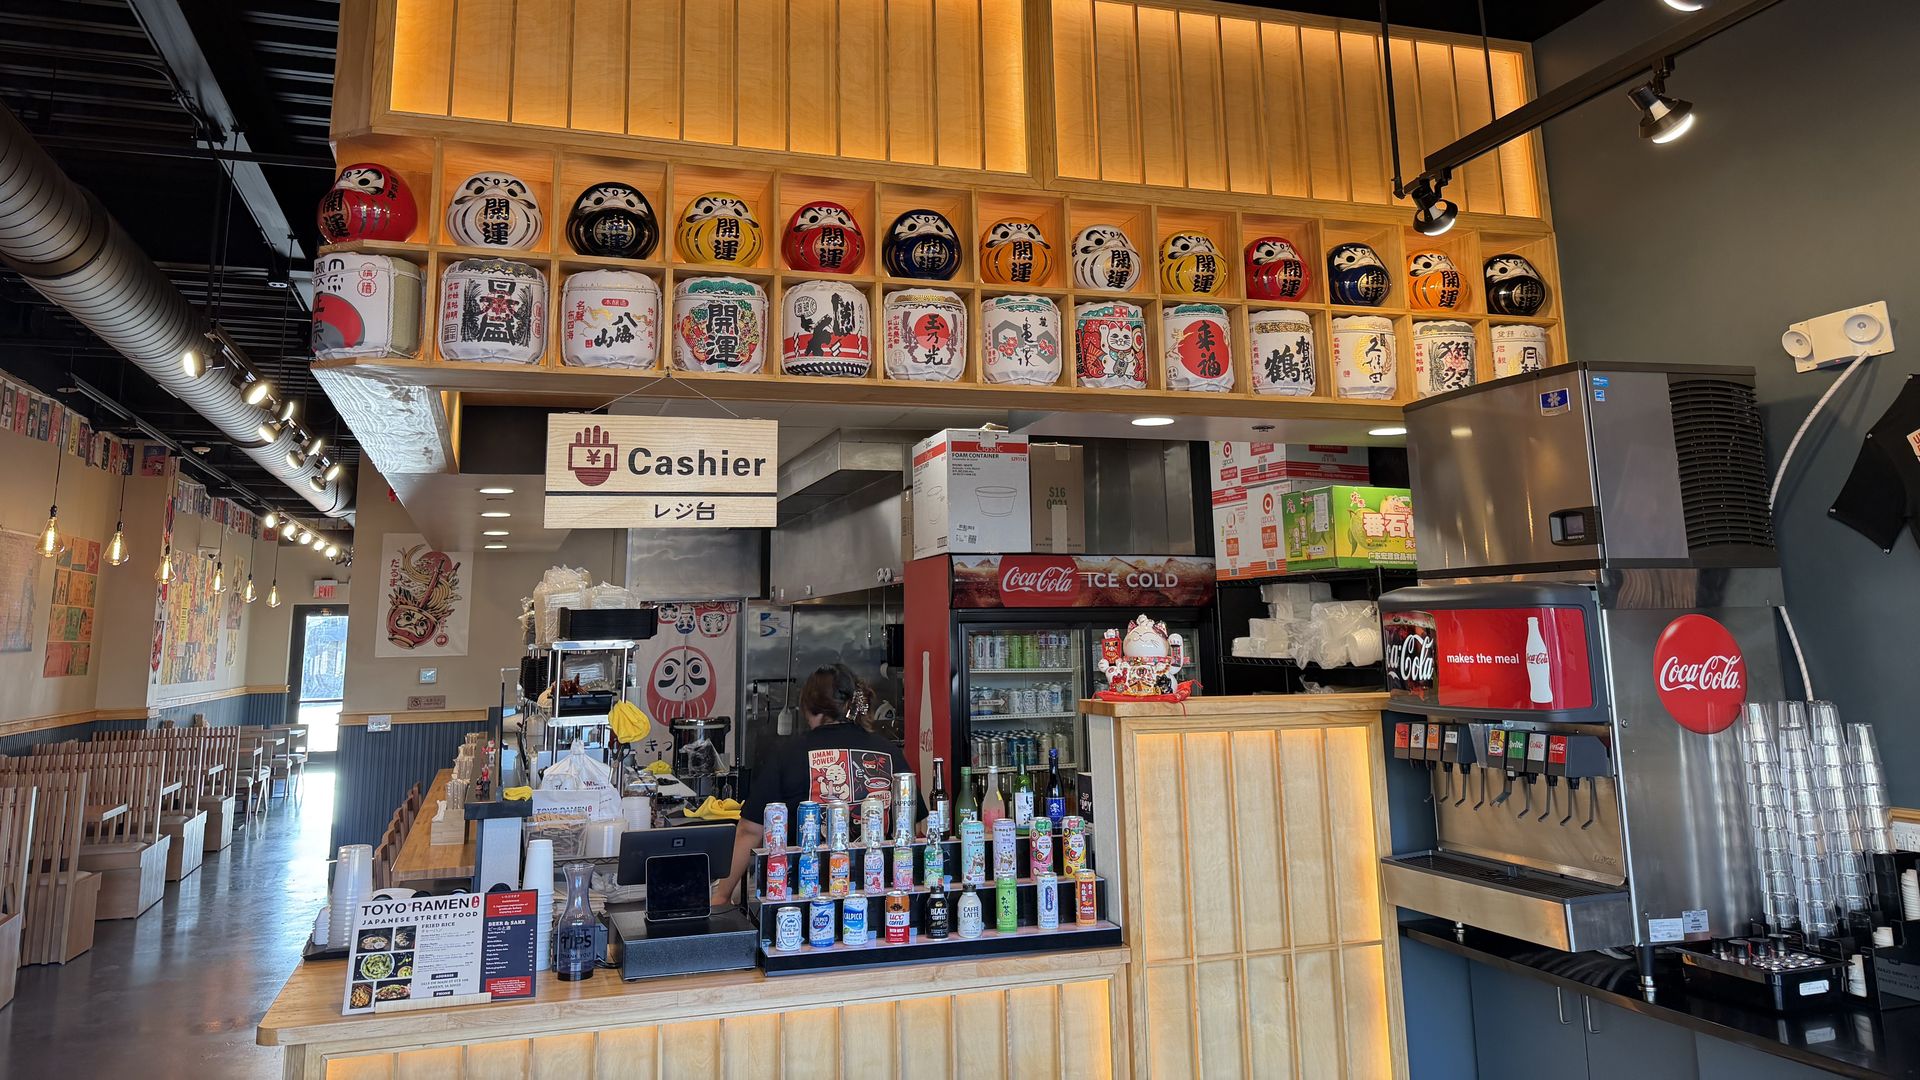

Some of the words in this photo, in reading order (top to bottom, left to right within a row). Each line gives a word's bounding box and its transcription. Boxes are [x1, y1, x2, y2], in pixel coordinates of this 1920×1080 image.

[482, 197, 510, 245] 開運
[714, 217, 740, 261] 開運
[820, 226, 845, 269] 開運
[1010, 239, 1033, 283] 開運
[1106, 249, 1132, 289] 開運
[1191, 254, 1216, 294] 開運
[1280, 259, 1302, 298] 開運
[1439, 270, 1460, 309] 開運
[706, 304, 743, 367] 開運
[925, 313, 945, 366] 玉乃光
[627, 447, 766, 477] Cashier
[969, 452, 1000, 460] CONTAINER
[1049, 487, 1066, 498] S16
[654, 501, 716, 521] レジ台
[1002, 566, 1073, 594] Coca-Cola
[1087, 573, 1120, 589] ICE
[1126, 572, 1179, 589] COLD
[1446, 653, 1474, 664] makes
[1477, 653, 1492, 664] the
[1496, 653, 1519, 665] meal
[1659, 654, 1742, 692] Coca-Cola
[811, 751, 834, 760] UMAMI
[812, 757, 836, 767] POWER!
[361, 902, 407, 916] TOYO
[411, 898, 470, 913] RAMEN
[362, 916, 411, 926] JAPANESE
[414, 913, 450, 922] STREET
[452, 911, 478, 919] FOOD
[561, 934, 592, 950] TIPS
